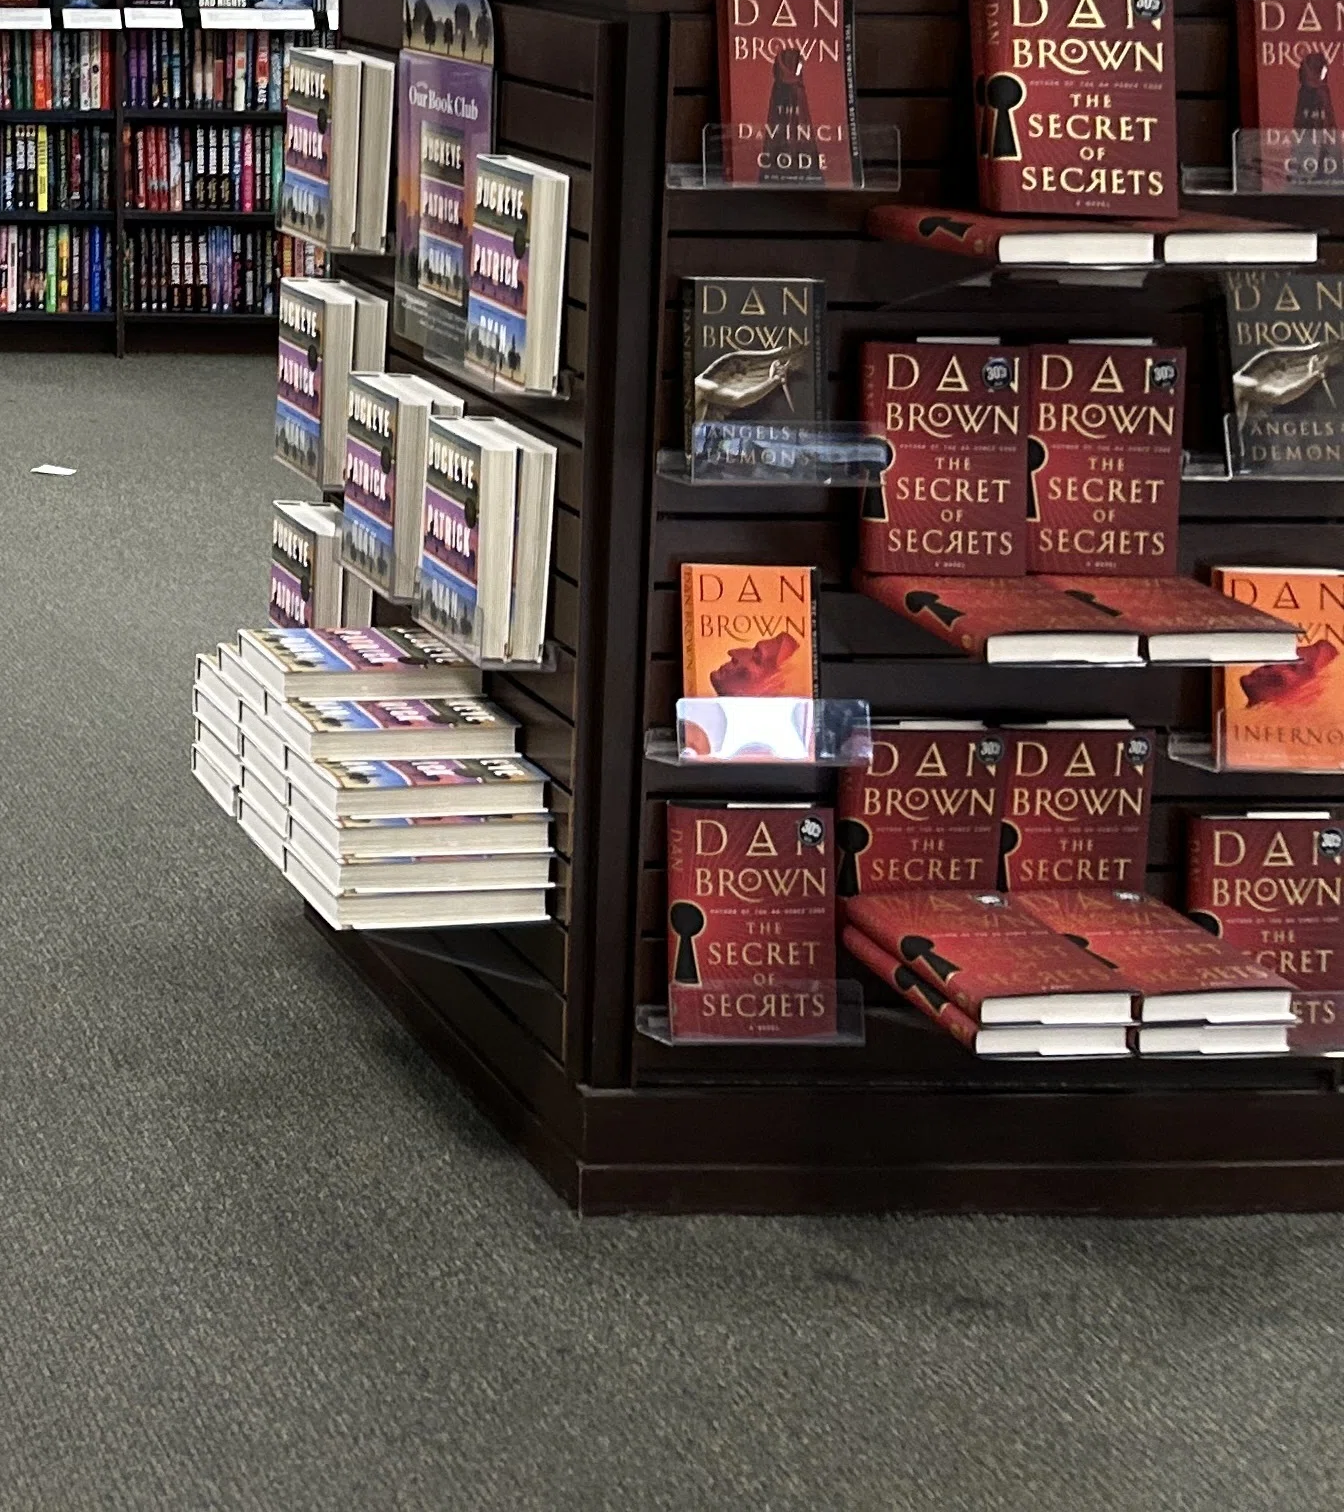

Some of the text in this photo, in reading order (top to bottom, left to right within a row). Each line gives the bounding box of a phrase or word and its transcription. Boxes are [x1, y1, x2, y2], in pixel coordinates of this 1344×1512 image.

[734, 37, 839, 63] BROWN
[1013, 39, 1163, 73] BROWN
[409, 87, 479, 122] Our Book Club
[1070, 93, 1111, 108] THE
[1028, 115, 1157, 141] SECRET
[756, 152, 828, 169] CODE
[1080, 146, 1105, 161] OF
[1022, 168, 1163, 196] SECRETS
[476, 175, 524, 221] BUCKEYE
[475, 242, 519, 290] PATRICK
[702, 285, 809, 314] DAN
[702, 325, 810, 350] BROWN
[886, 403, 1020, 437] BROWN
[1039, 404, 1174, 438] BROWN
[896, 478, 1010, 503] SECRET
[888, 528, 1013, 556] SECRETS
[699, 573, 807, 603] DAN
[700, 615, 806, 641] BROWN
[1234, 724, 1344, 745] INFERNO
[695, 868, 827, 901] BROWN
[708, 943, 820, 966] SECRET
[702, 994, 826, 1018] SECRETS
